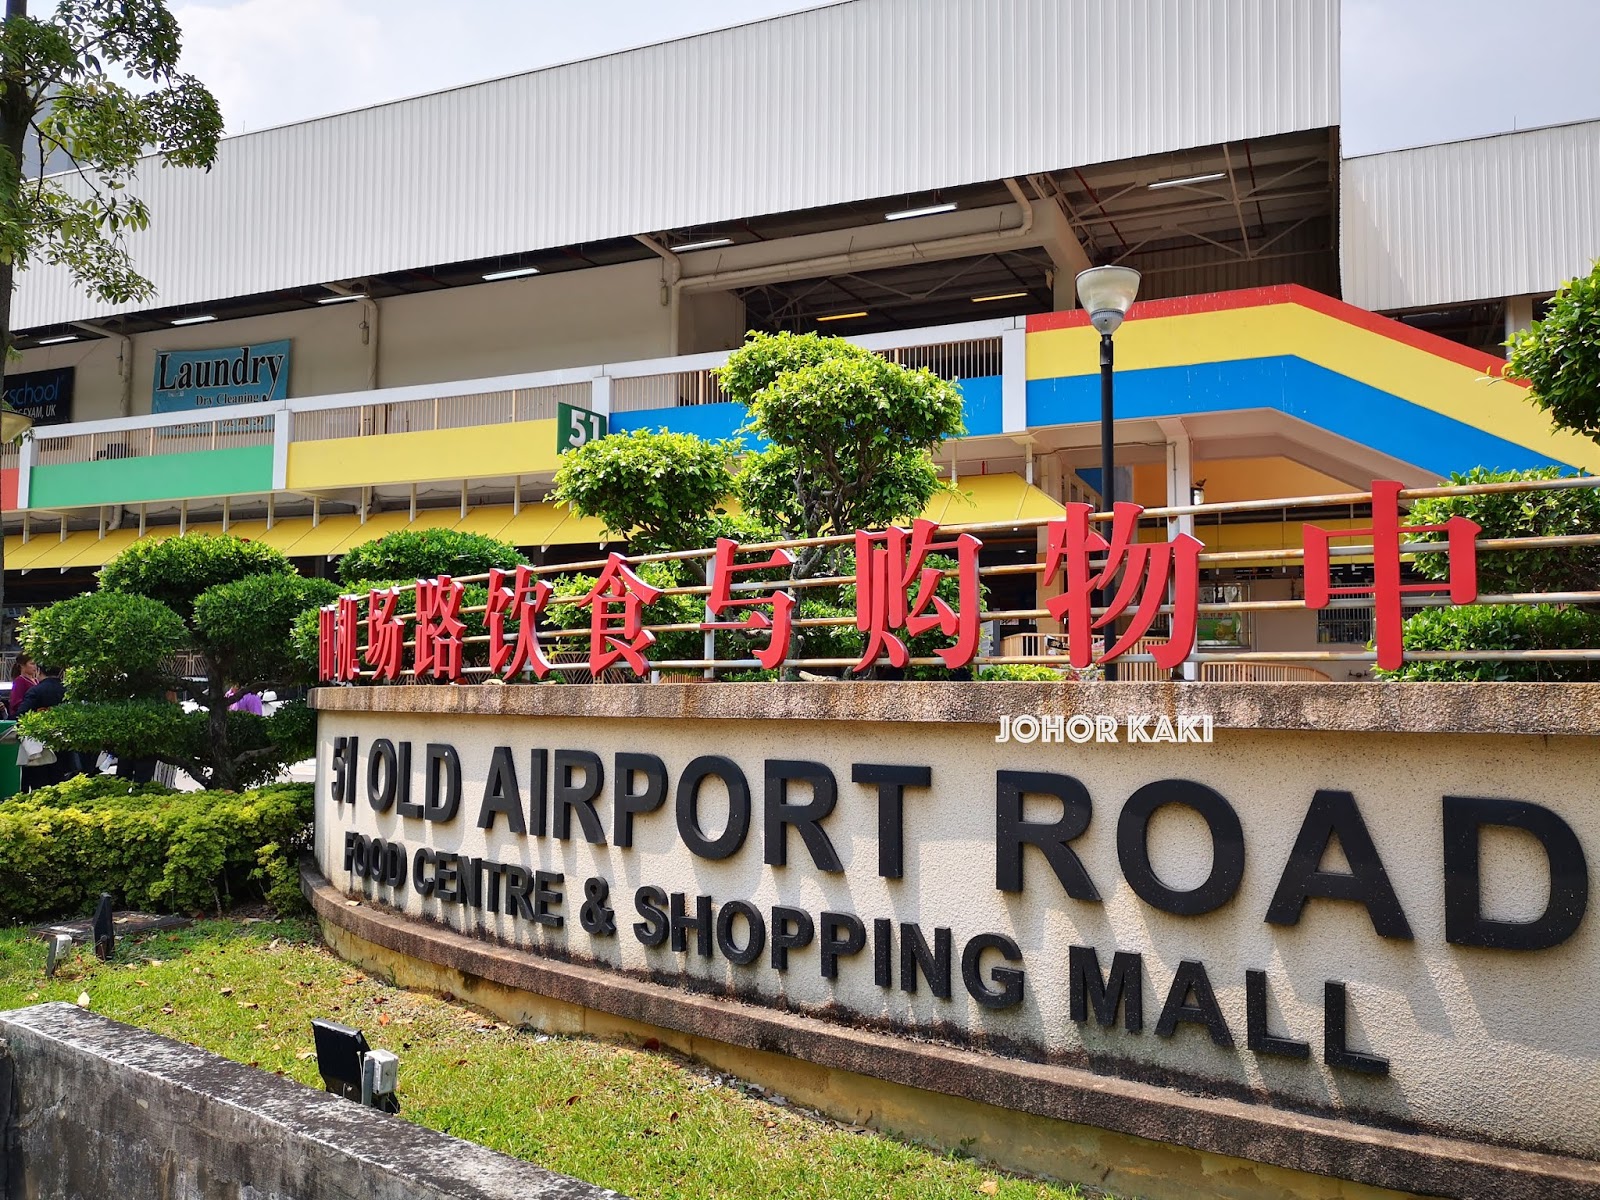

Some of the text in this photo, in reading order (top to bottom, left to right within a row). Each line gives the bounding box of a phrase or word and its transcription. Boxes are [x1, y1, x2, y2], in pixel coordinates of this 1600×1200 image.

[156, 346, 285, 402] Laundry
[45, 404, 56, 417] UK
[196, 392, 260, 406] Dry Cleaning
[568, 408, 600, 448] 51
[331, 736, 1588, 953] 51 OLD AIRPORT ROAD
[344, 831, 1390, 1076] FOOD CENTRE & SHOPPING MALL
